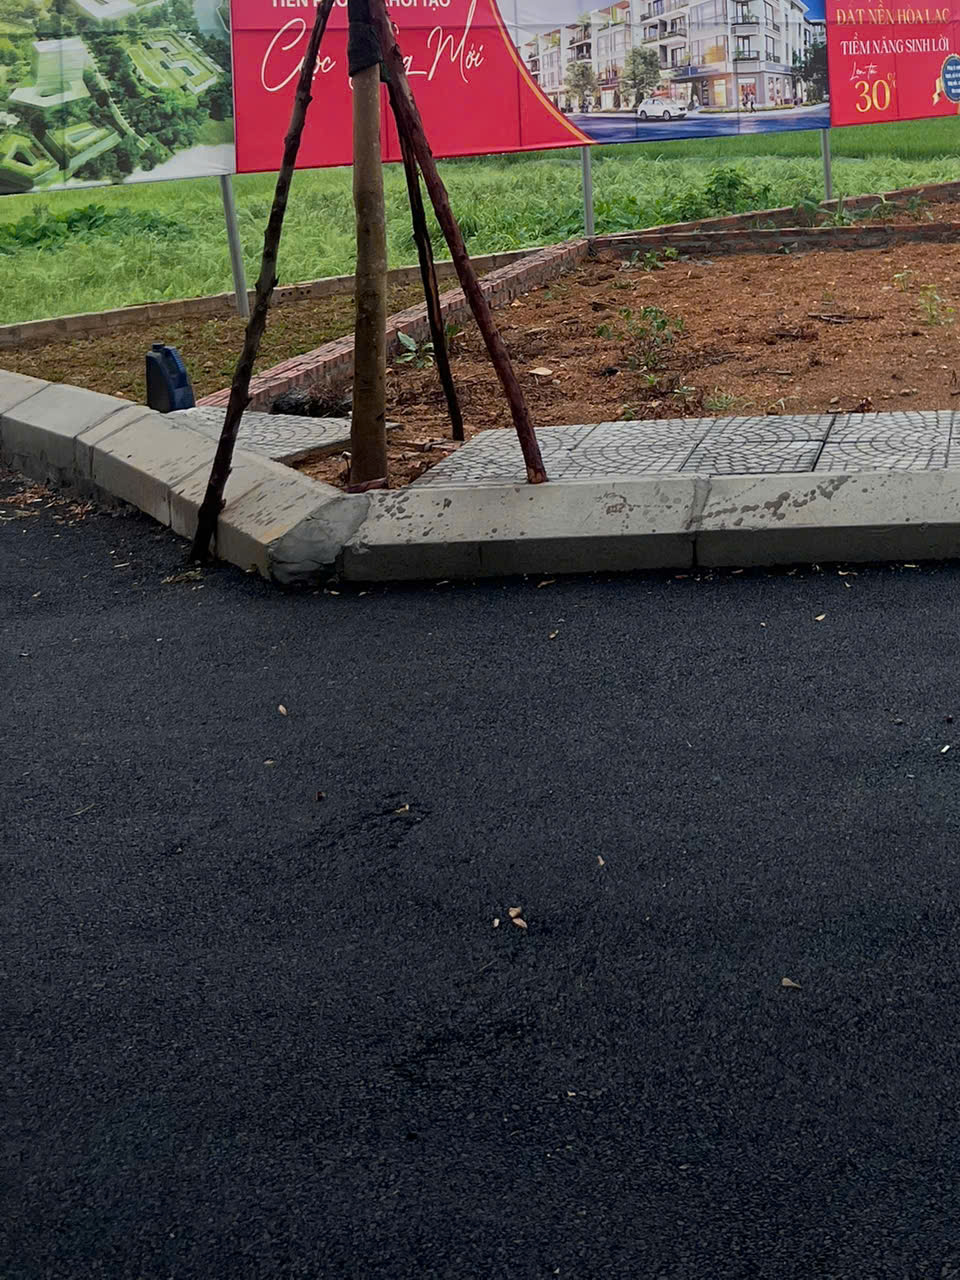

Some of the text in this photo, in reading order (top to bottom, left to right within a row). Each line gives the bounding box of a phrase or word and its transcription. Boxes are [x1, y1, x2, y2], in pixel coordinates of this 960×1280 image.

[840, 31, 871, 56] TIỀM
[872, 35, 905, 55] NĂNG
[905, 38, 931, 53] SINH
